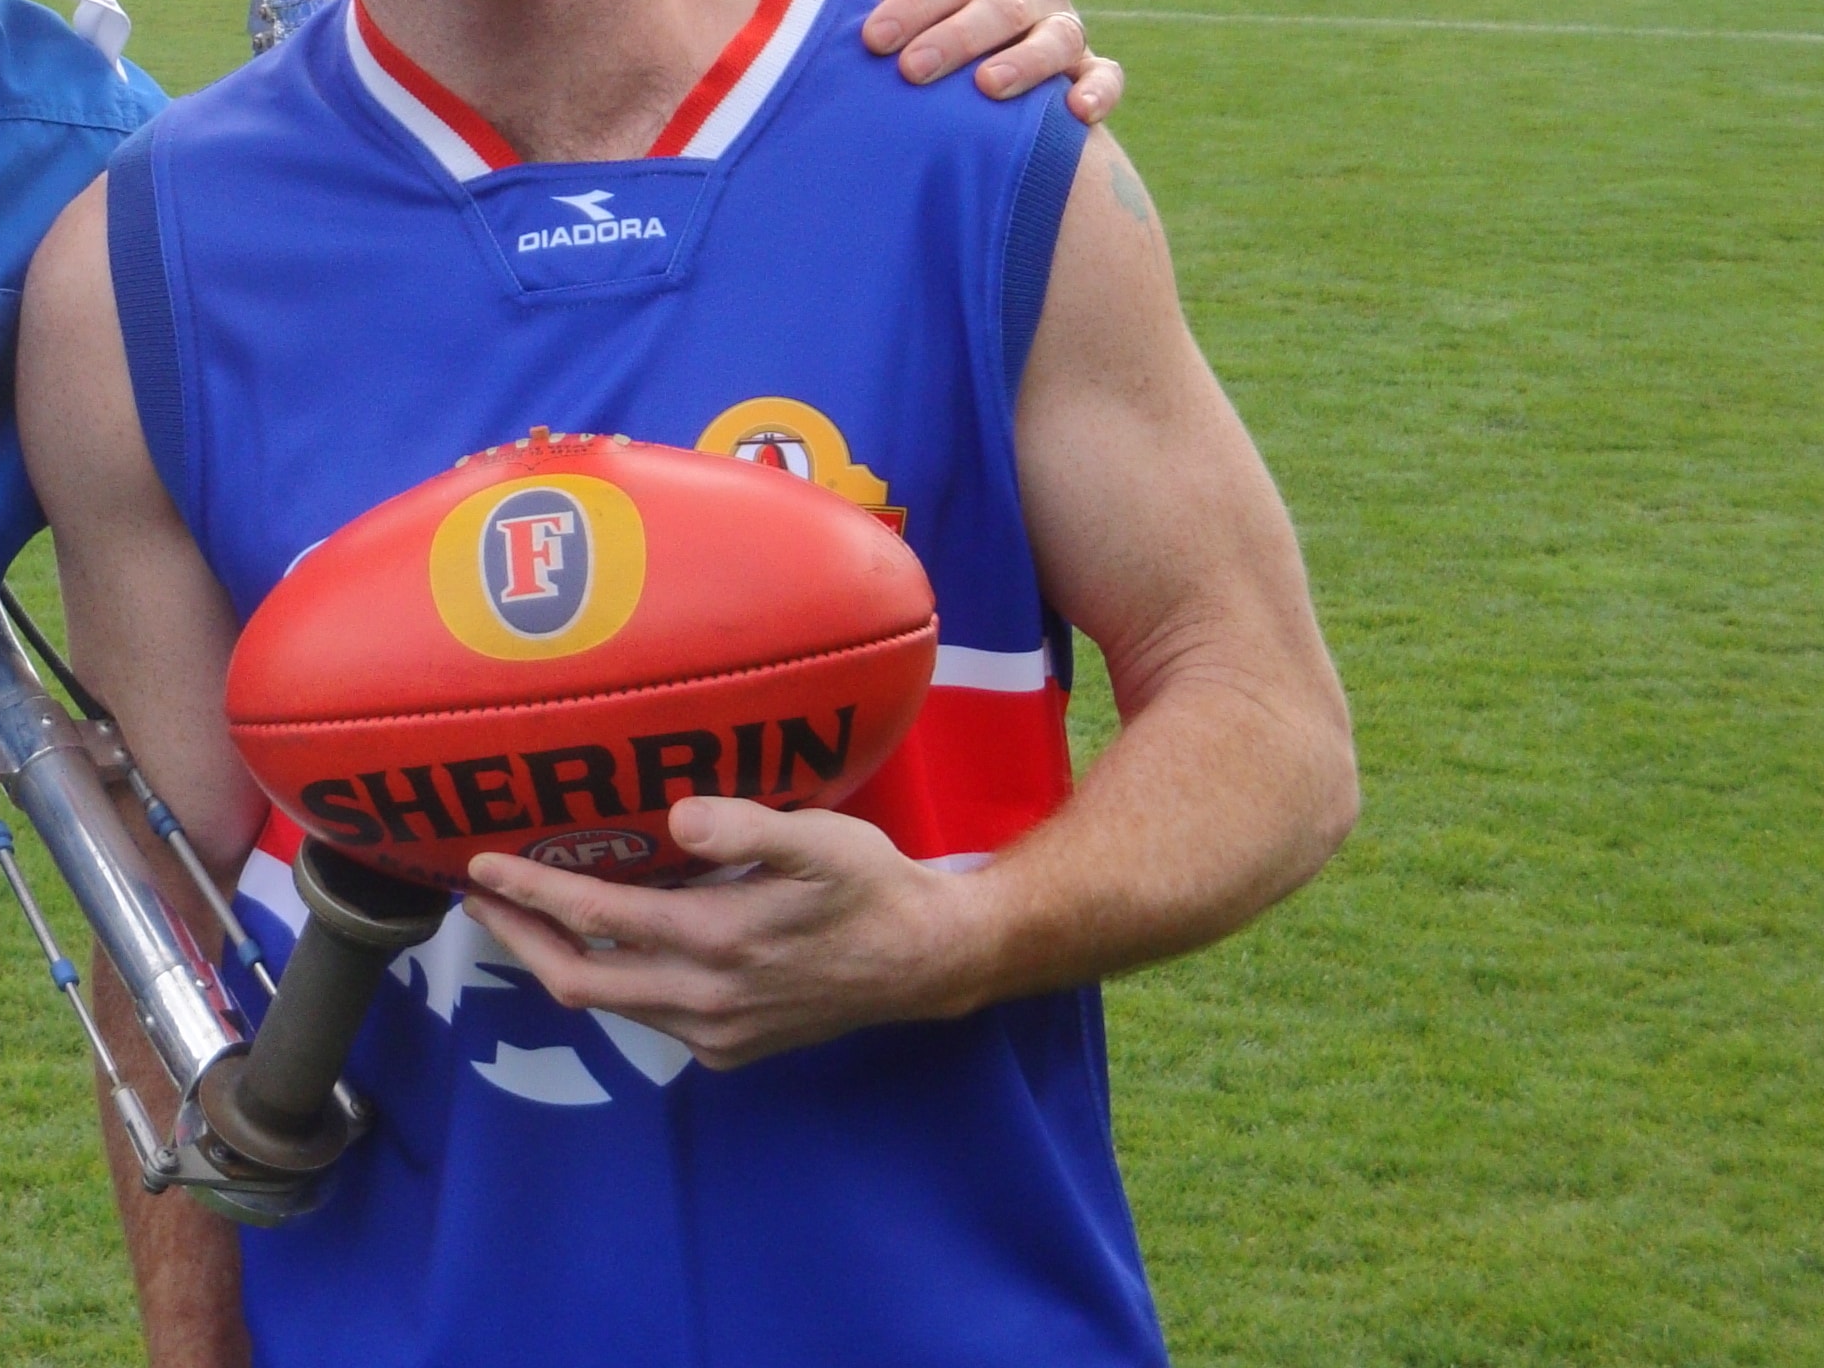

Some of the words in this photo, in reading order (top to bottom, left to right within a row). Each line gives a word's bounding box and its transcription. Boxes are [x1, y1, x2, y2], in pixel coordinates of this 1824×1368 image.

[518, 217, 667, 253] DIADORA
[496, 511, 574, 603] F
[300, 704, 857, 845] SHERRIN
[537, 835, 652, 868] AFL
